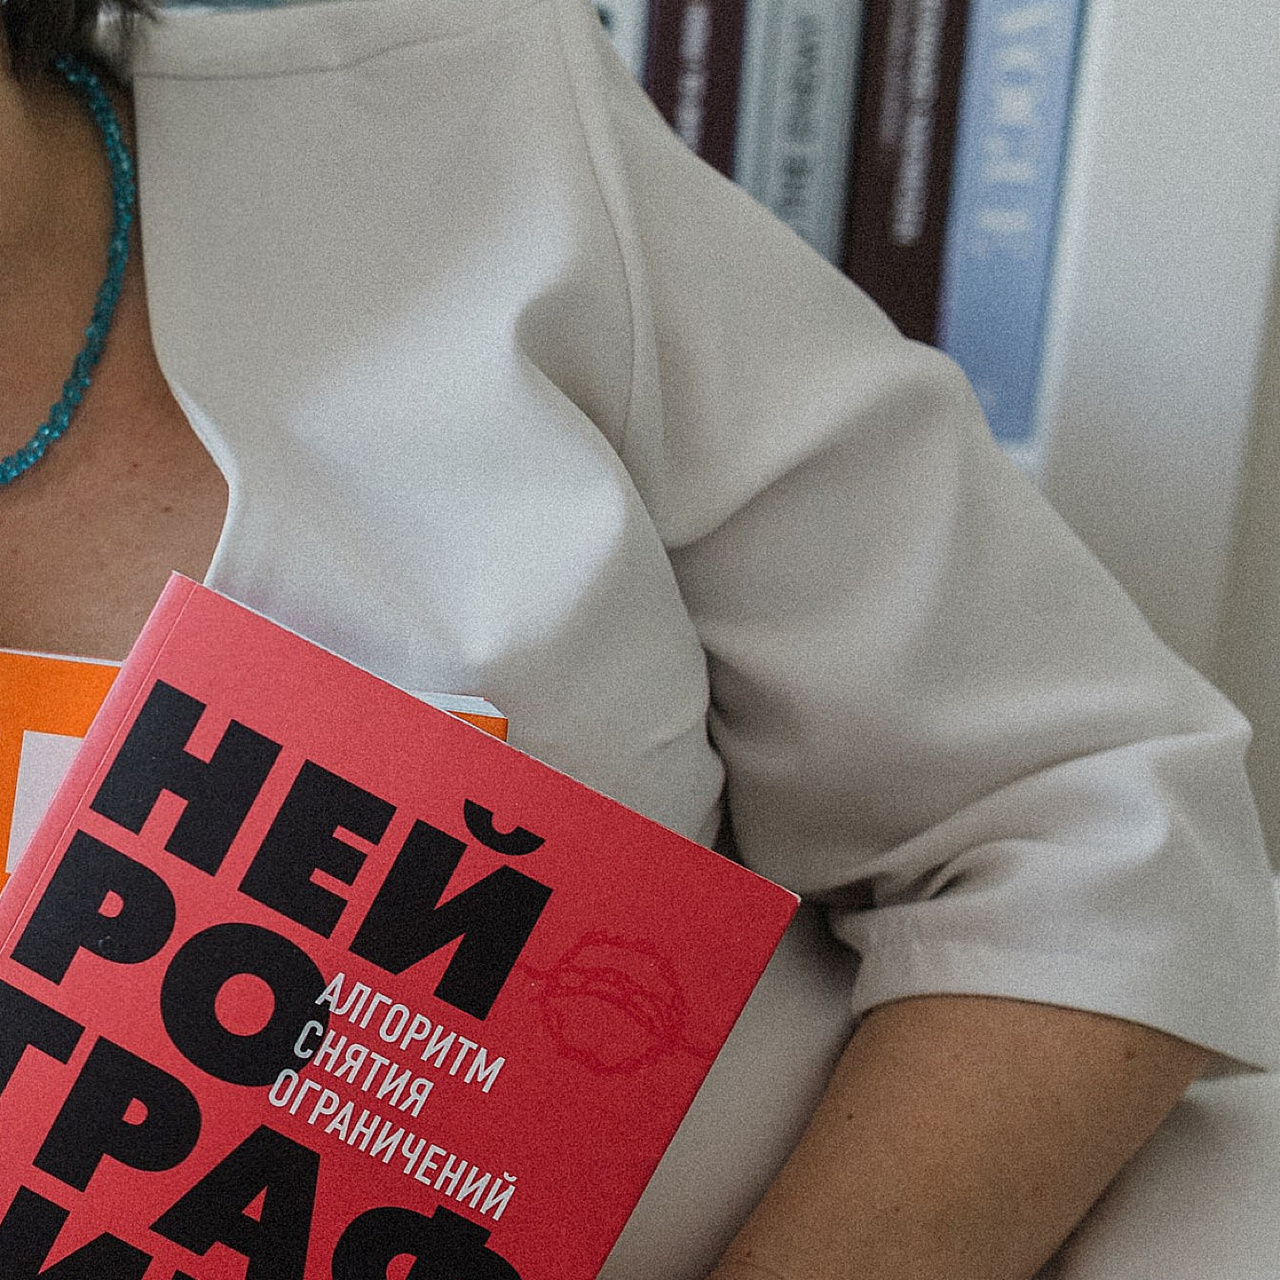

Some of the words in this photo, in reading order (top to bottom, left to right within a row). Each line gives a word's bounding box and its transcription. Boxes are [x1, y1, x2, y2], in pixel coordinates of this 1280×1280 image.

[89, 679, 554, 1021] НЕЙ
[9, 828, 329, 1088] РО
[314, 971, 506, 1093] АЛГОРИТМ
[269, 1067, 518, 1221] ОГРАНИЧЕНИЙ
[293, 1020, 435, 1118] СНЯТИЯ
